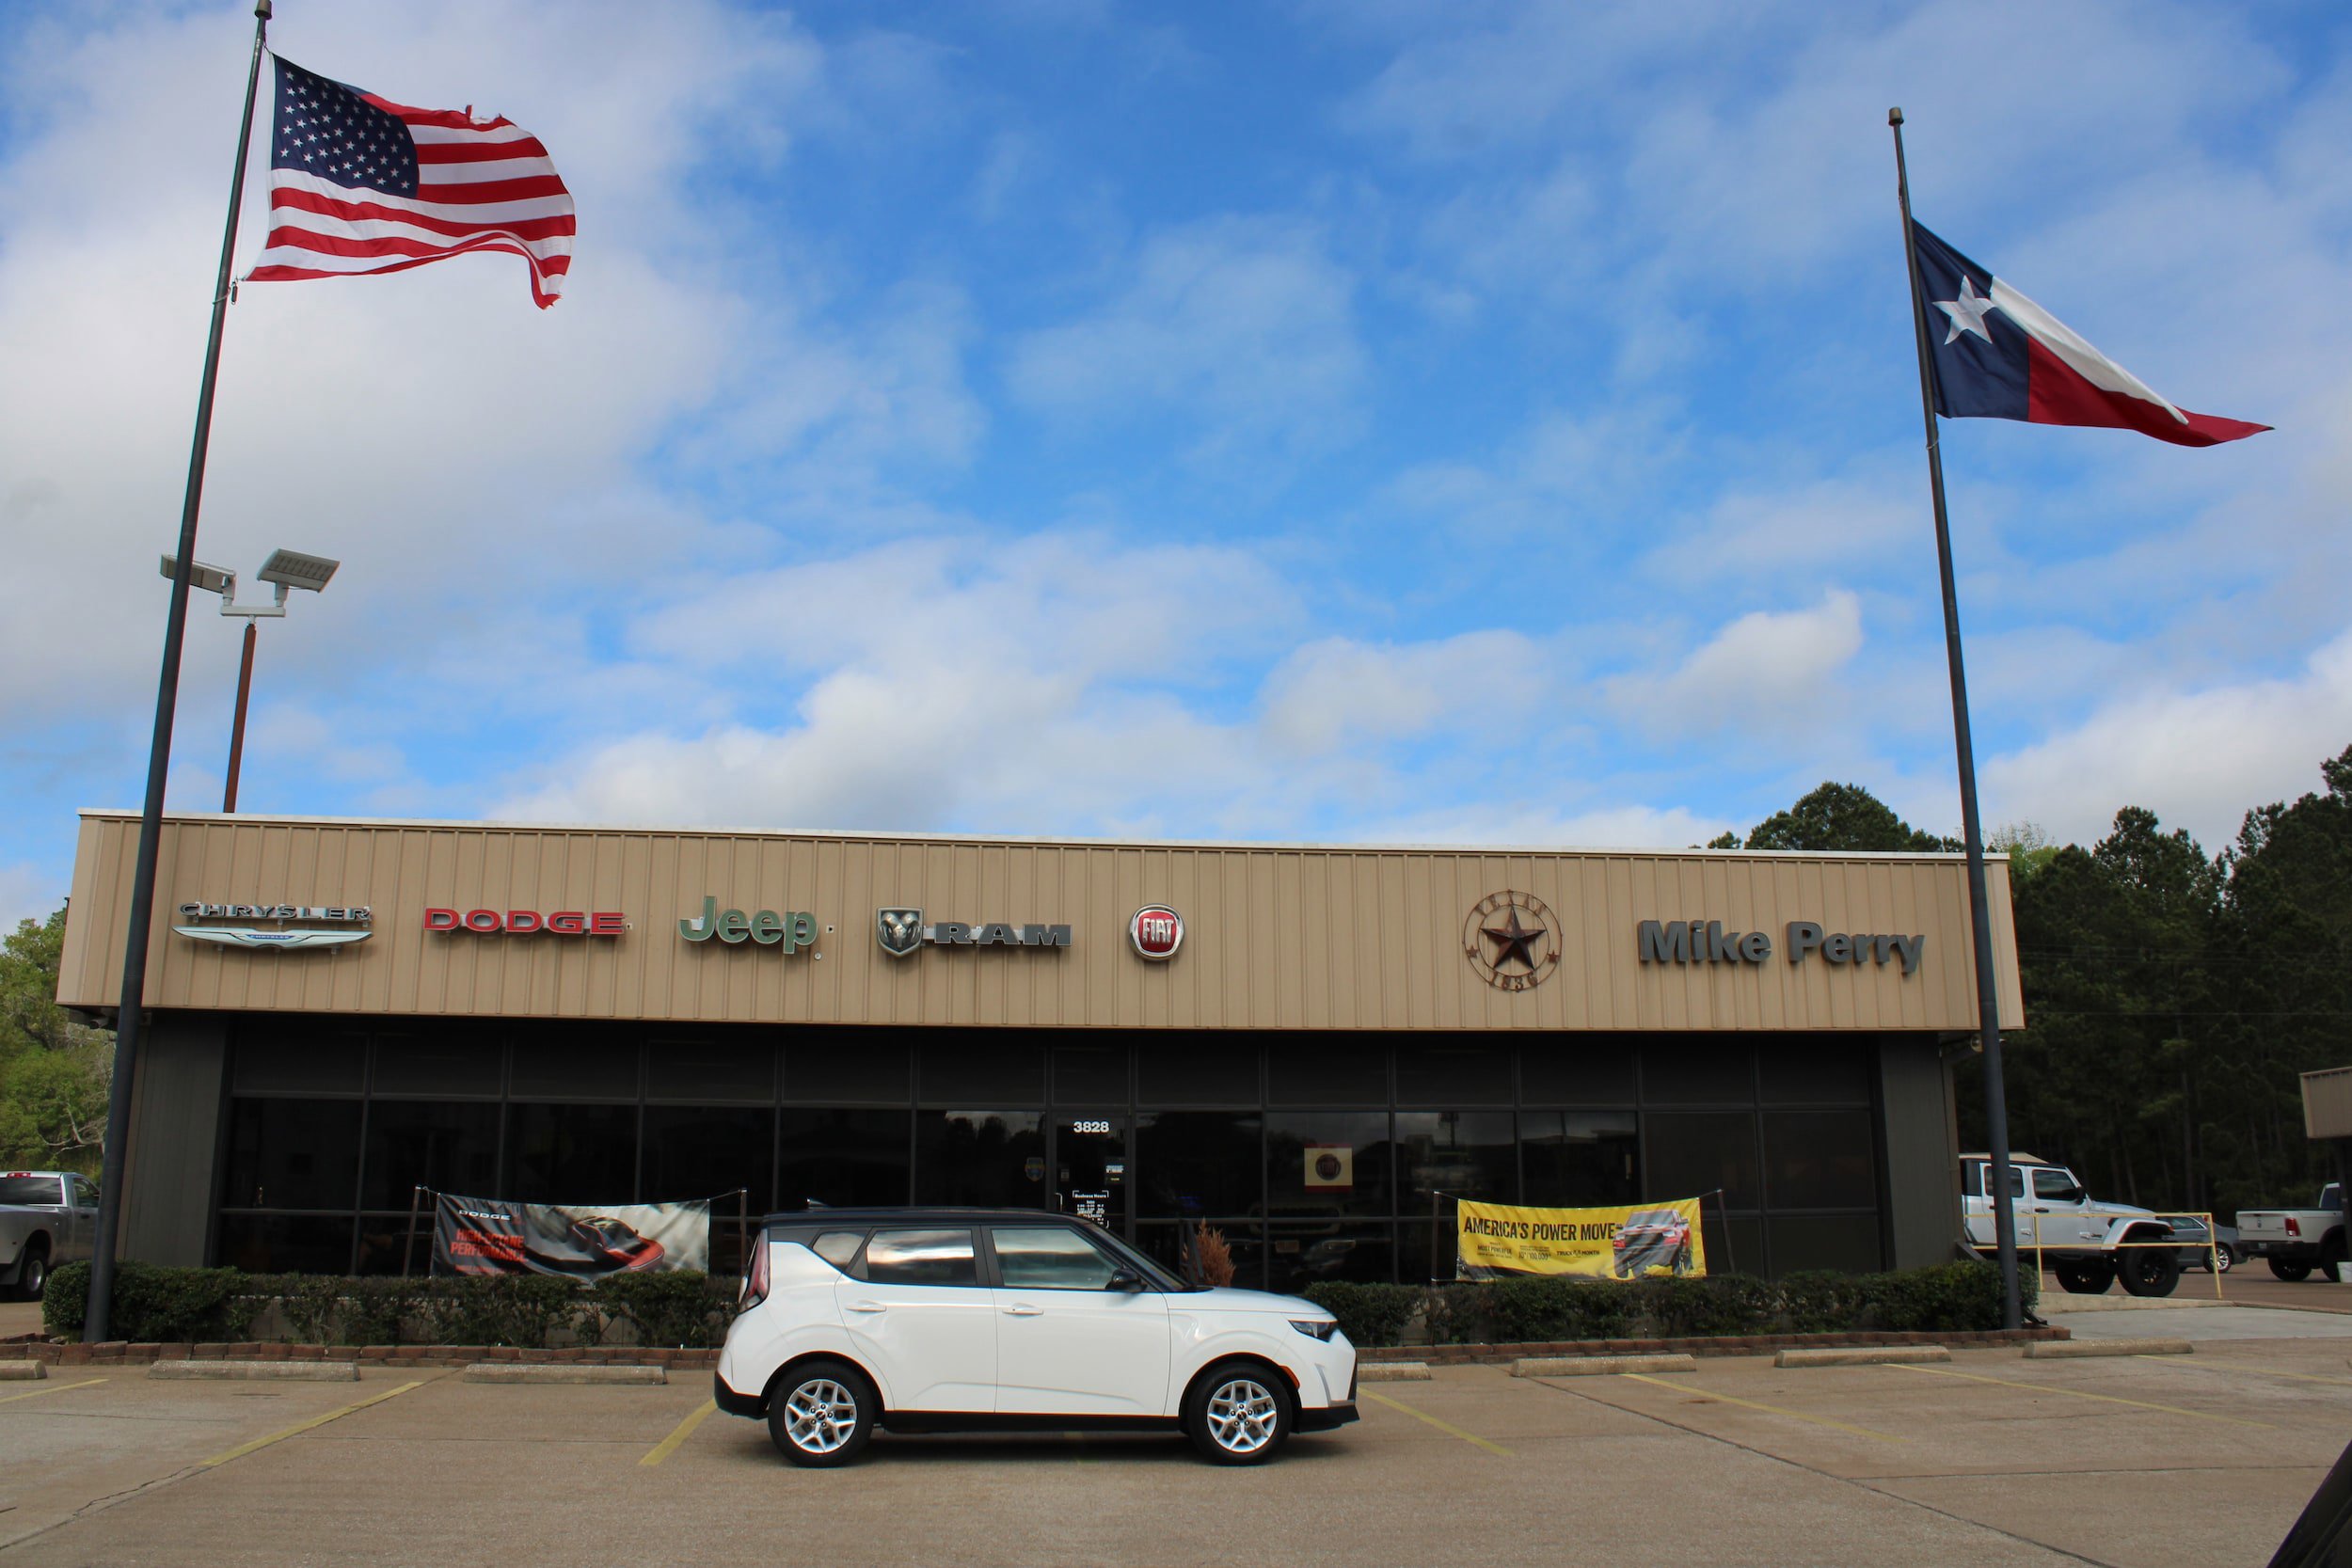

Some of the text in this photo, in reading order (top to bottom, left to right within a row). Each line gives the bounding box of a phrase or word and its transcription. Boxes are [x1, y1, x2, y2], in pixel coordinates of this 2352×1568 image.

[179, 903, 371, 921] CHRYSLER
[424, 908, 624, 934] DODGE
[678, 895, 818, 954] Jeep
[934, 922, 1072, 945] RAM
[1142, 918, 1174, 943] FIAT
[1638, 919, 1925, 974] Mike Perry
[1073, 1121, 1110, 1133] 3828
[458, 1210, 511, 1221] DODGE
[1464, 1216, 1529, 1240] AMERICA'S
[1533, 1223, 1577, 1241] POWER
